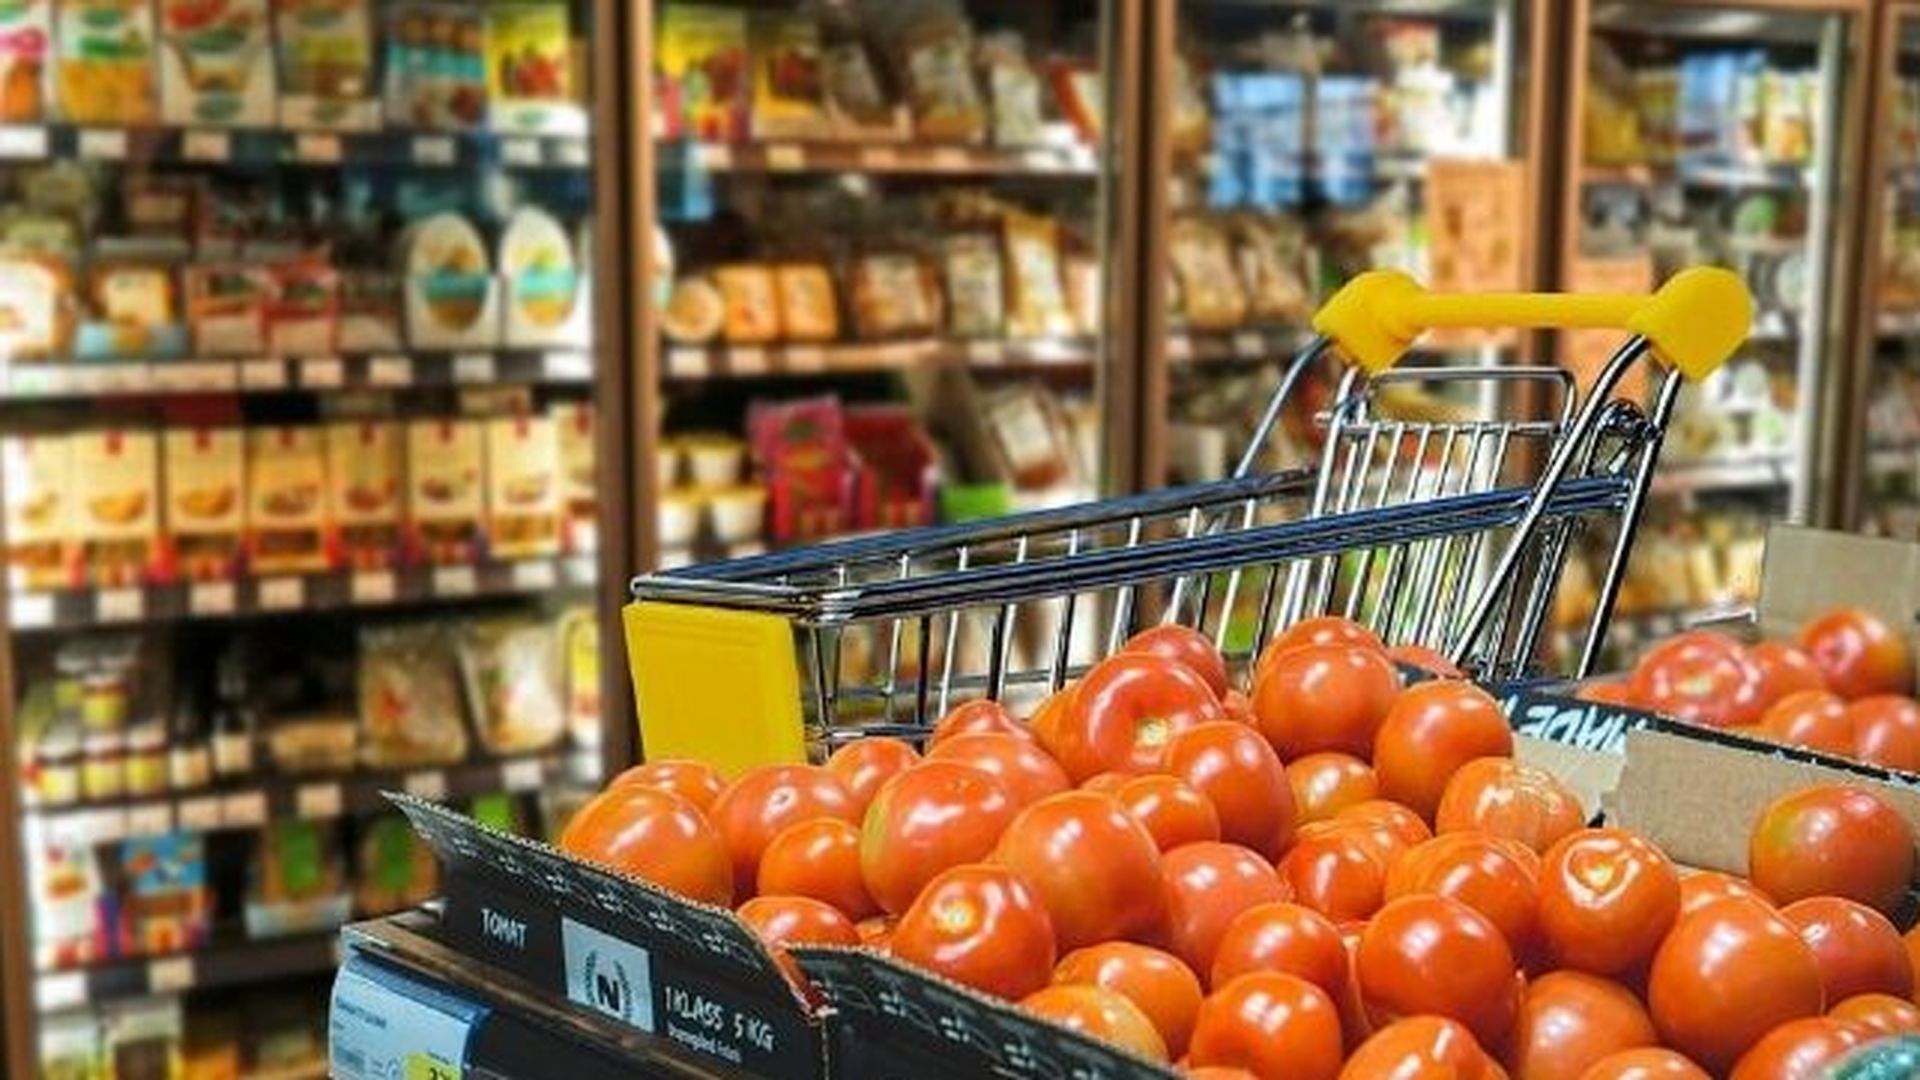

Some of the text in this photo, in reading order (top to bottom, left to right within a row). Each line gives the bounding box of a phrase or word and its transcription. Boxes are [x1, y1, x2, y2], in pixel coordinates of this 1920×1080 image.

[480, 908, 527, 949] TOMAT
[673, 989, 723, 1031] KLASS
[733, 1013, 744, 1038] 5
